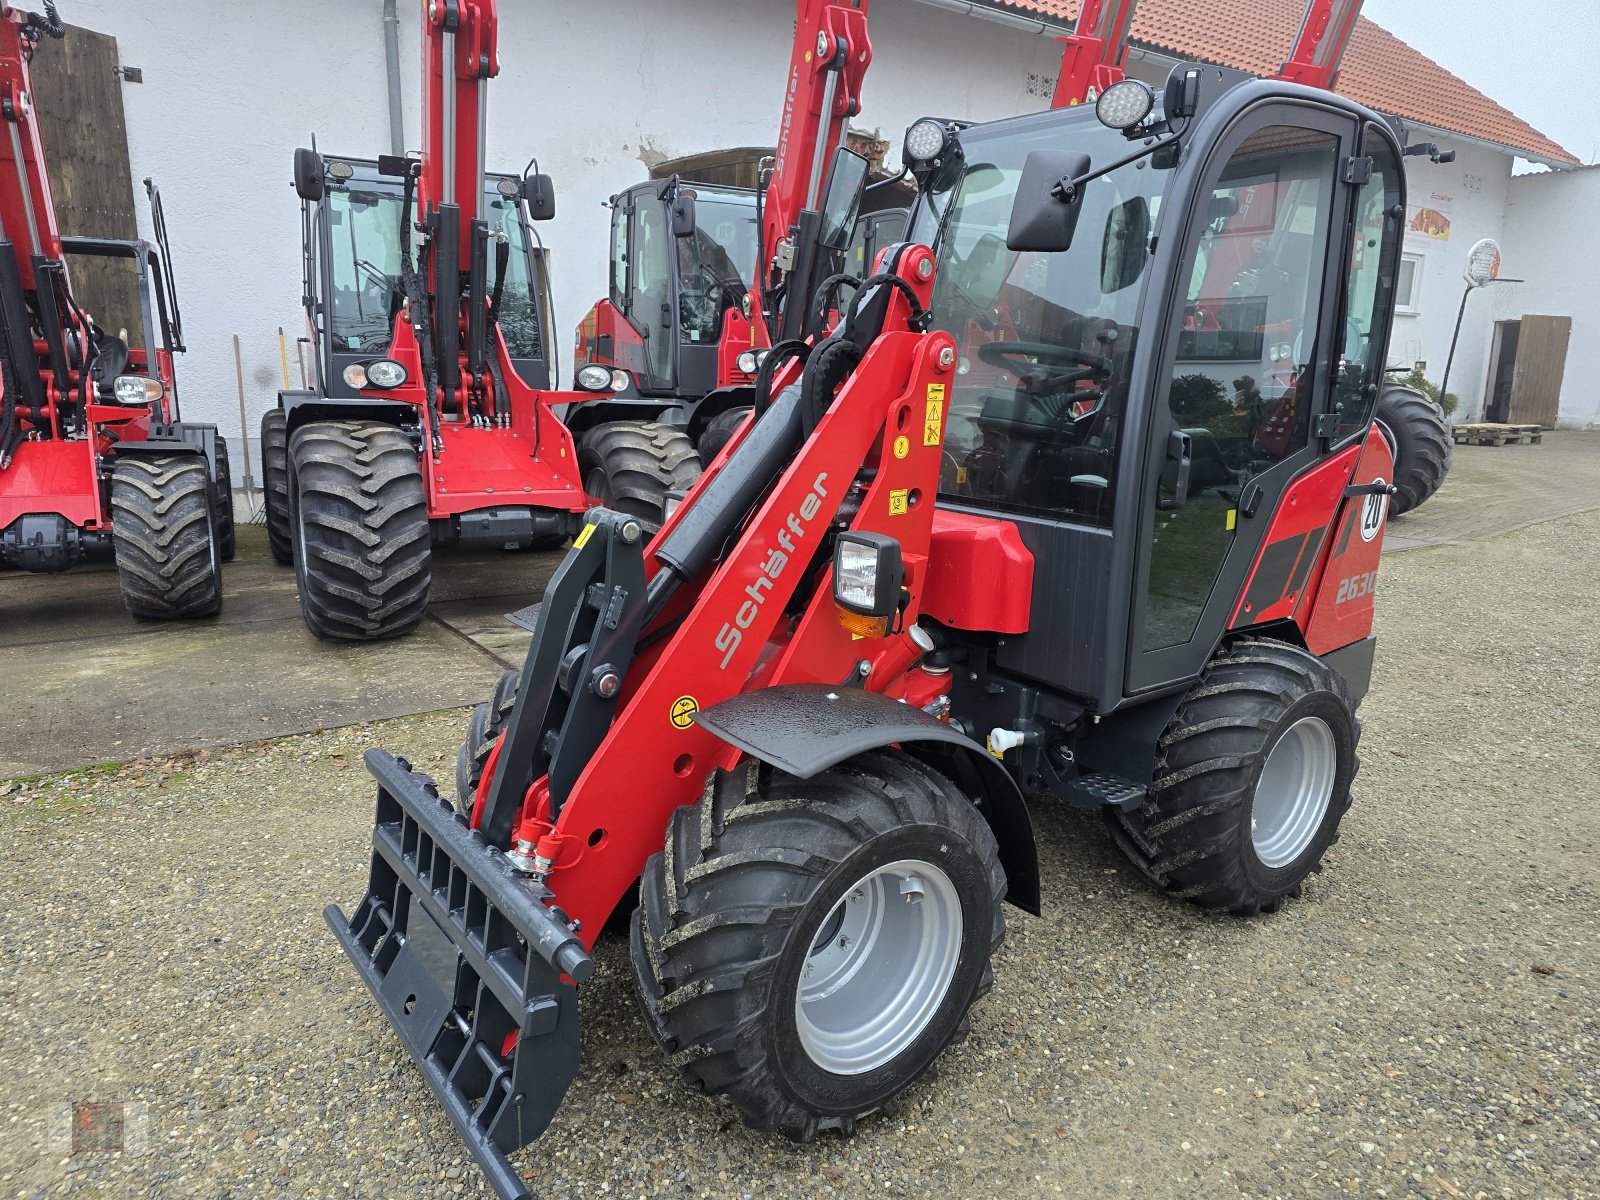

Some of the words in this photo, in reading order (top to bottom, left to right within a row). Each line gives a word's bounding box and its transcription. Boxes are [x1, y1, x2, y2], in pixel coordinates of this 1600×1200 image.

[776, 65, 799, 179] Schäffer
[1364, 494, 1382, 529] 20
[714, 472, 828, 670] Schäffer
